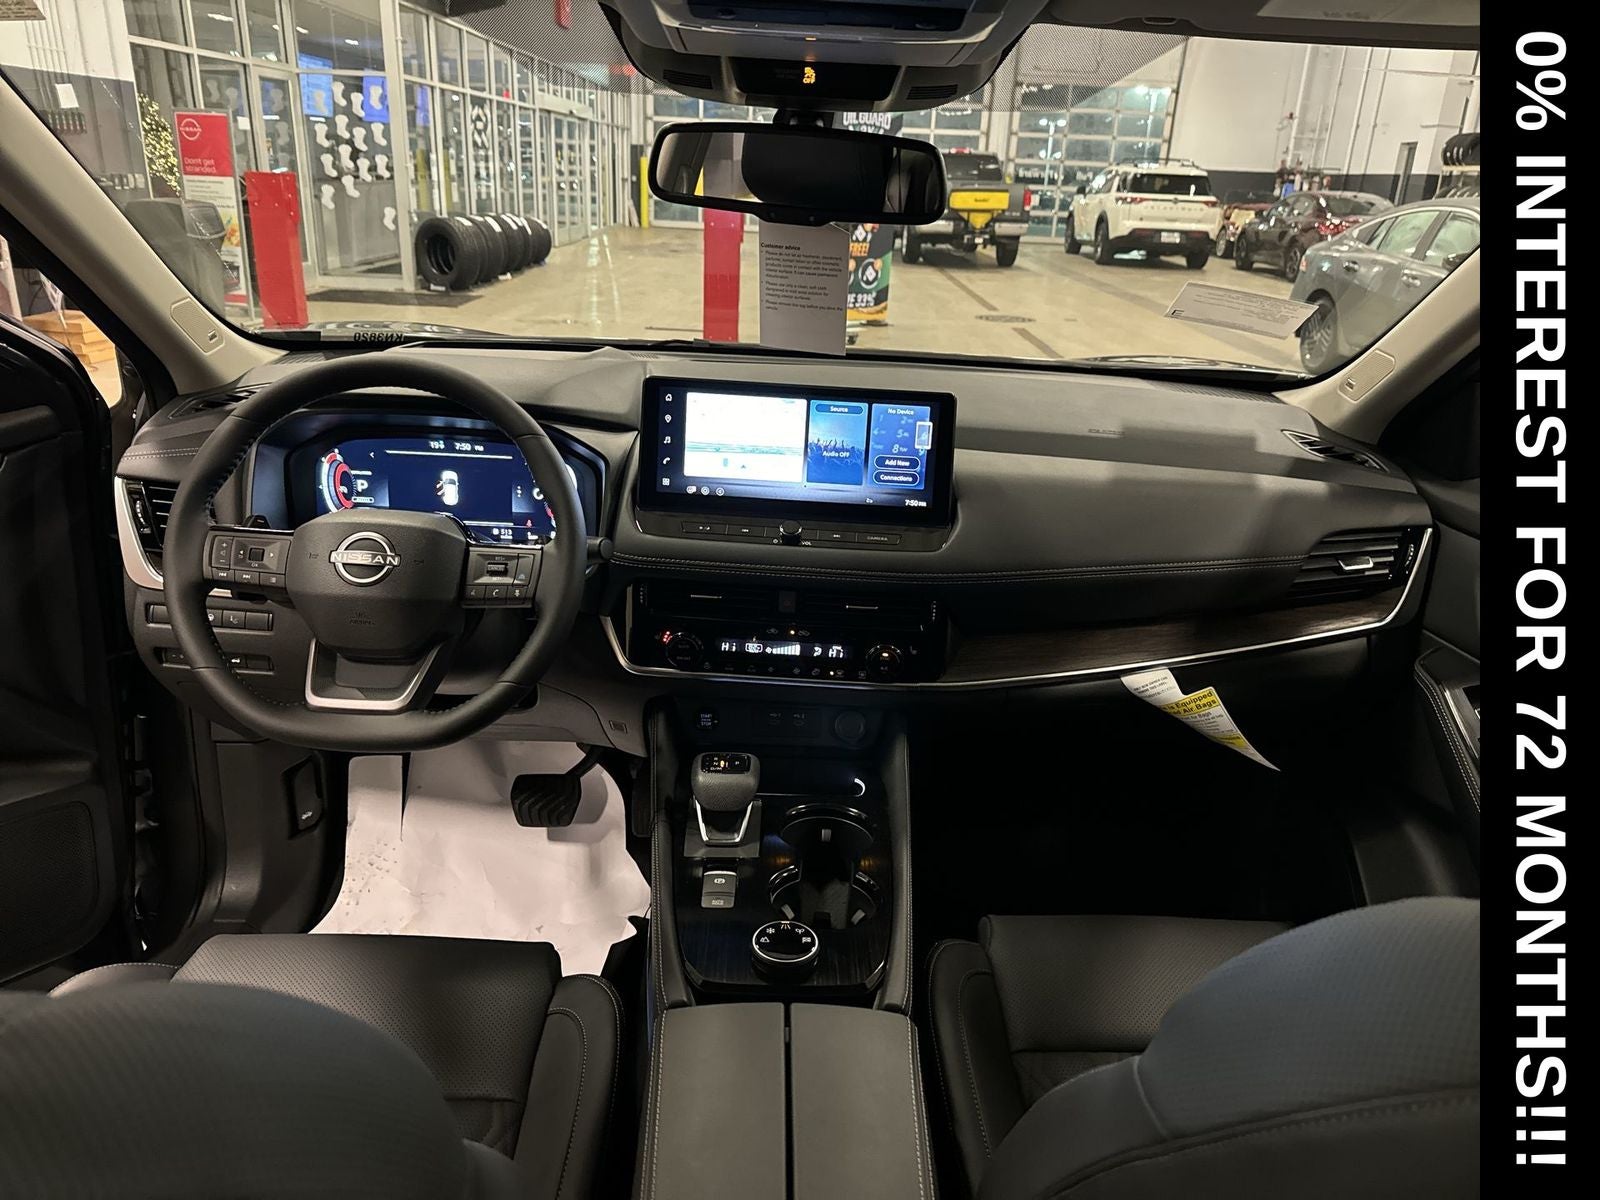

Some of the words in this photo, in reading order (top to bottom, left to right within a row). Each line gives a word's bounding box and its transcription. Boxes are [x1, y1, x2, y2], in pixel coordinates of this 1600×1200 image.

[202, 158, 216, 168] get
[822, 450, 838, 458] Audio
[880, 474, 913, 482] Connections
[356, 479, 368, 492] P
[332, 551, 399, 566] NISSAN
[1175, 690, 1213, 710] Equipped
[1182, 704, 1195, 714] Air
[1195, 699, 1217, 710] Bags
